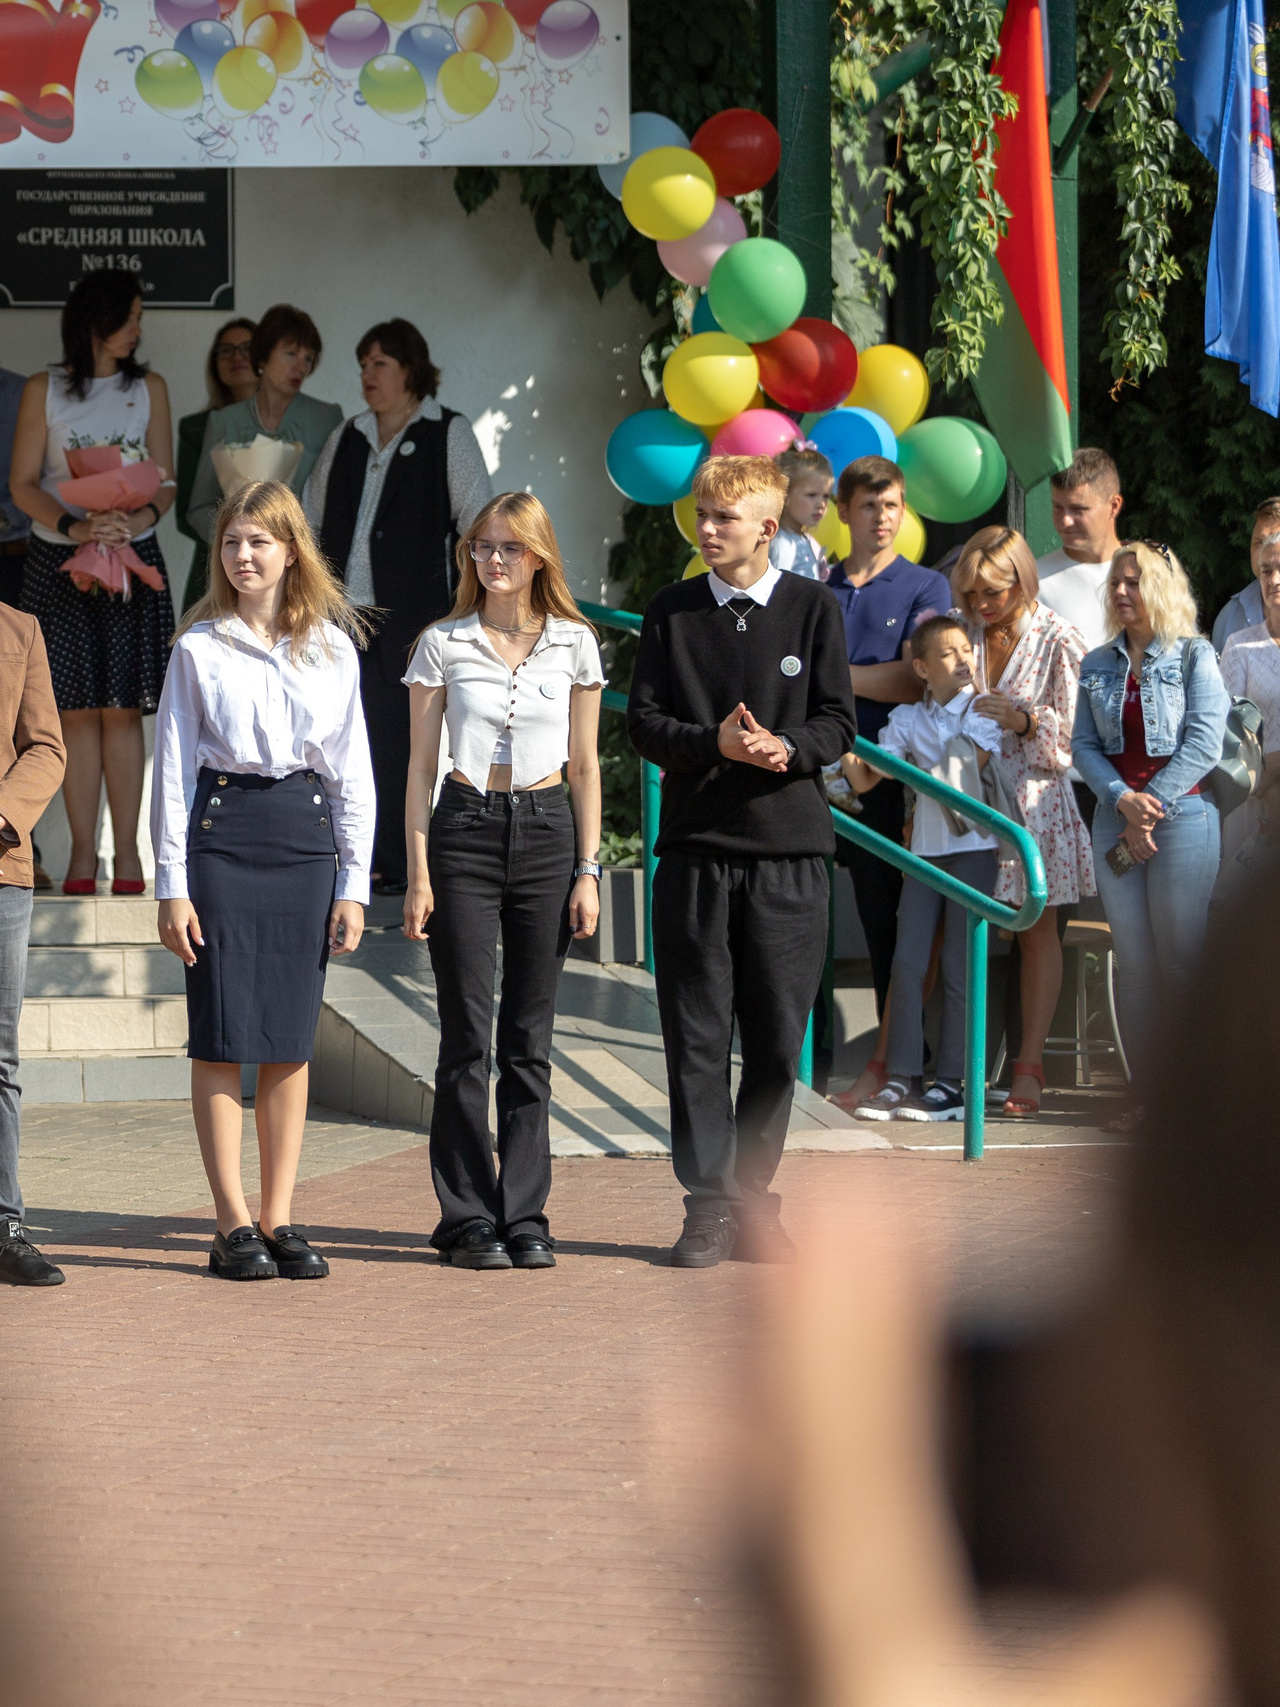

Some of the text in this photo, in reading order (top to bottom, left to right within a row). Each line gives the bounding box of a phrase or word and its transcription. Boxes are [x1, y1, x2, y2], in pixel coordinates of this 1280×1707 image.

[16, 190, 205, 203] ГОСУДАРСТВЕННОЕ УЧРЕЖДЕНИЕ
[69, 205, 153, 216] ОБРАЗОВАНИЯ
[17, 227, 206, 248] «СРЕДНЯЯ ШКОЛА
[81, 254, 142, 272] №136
